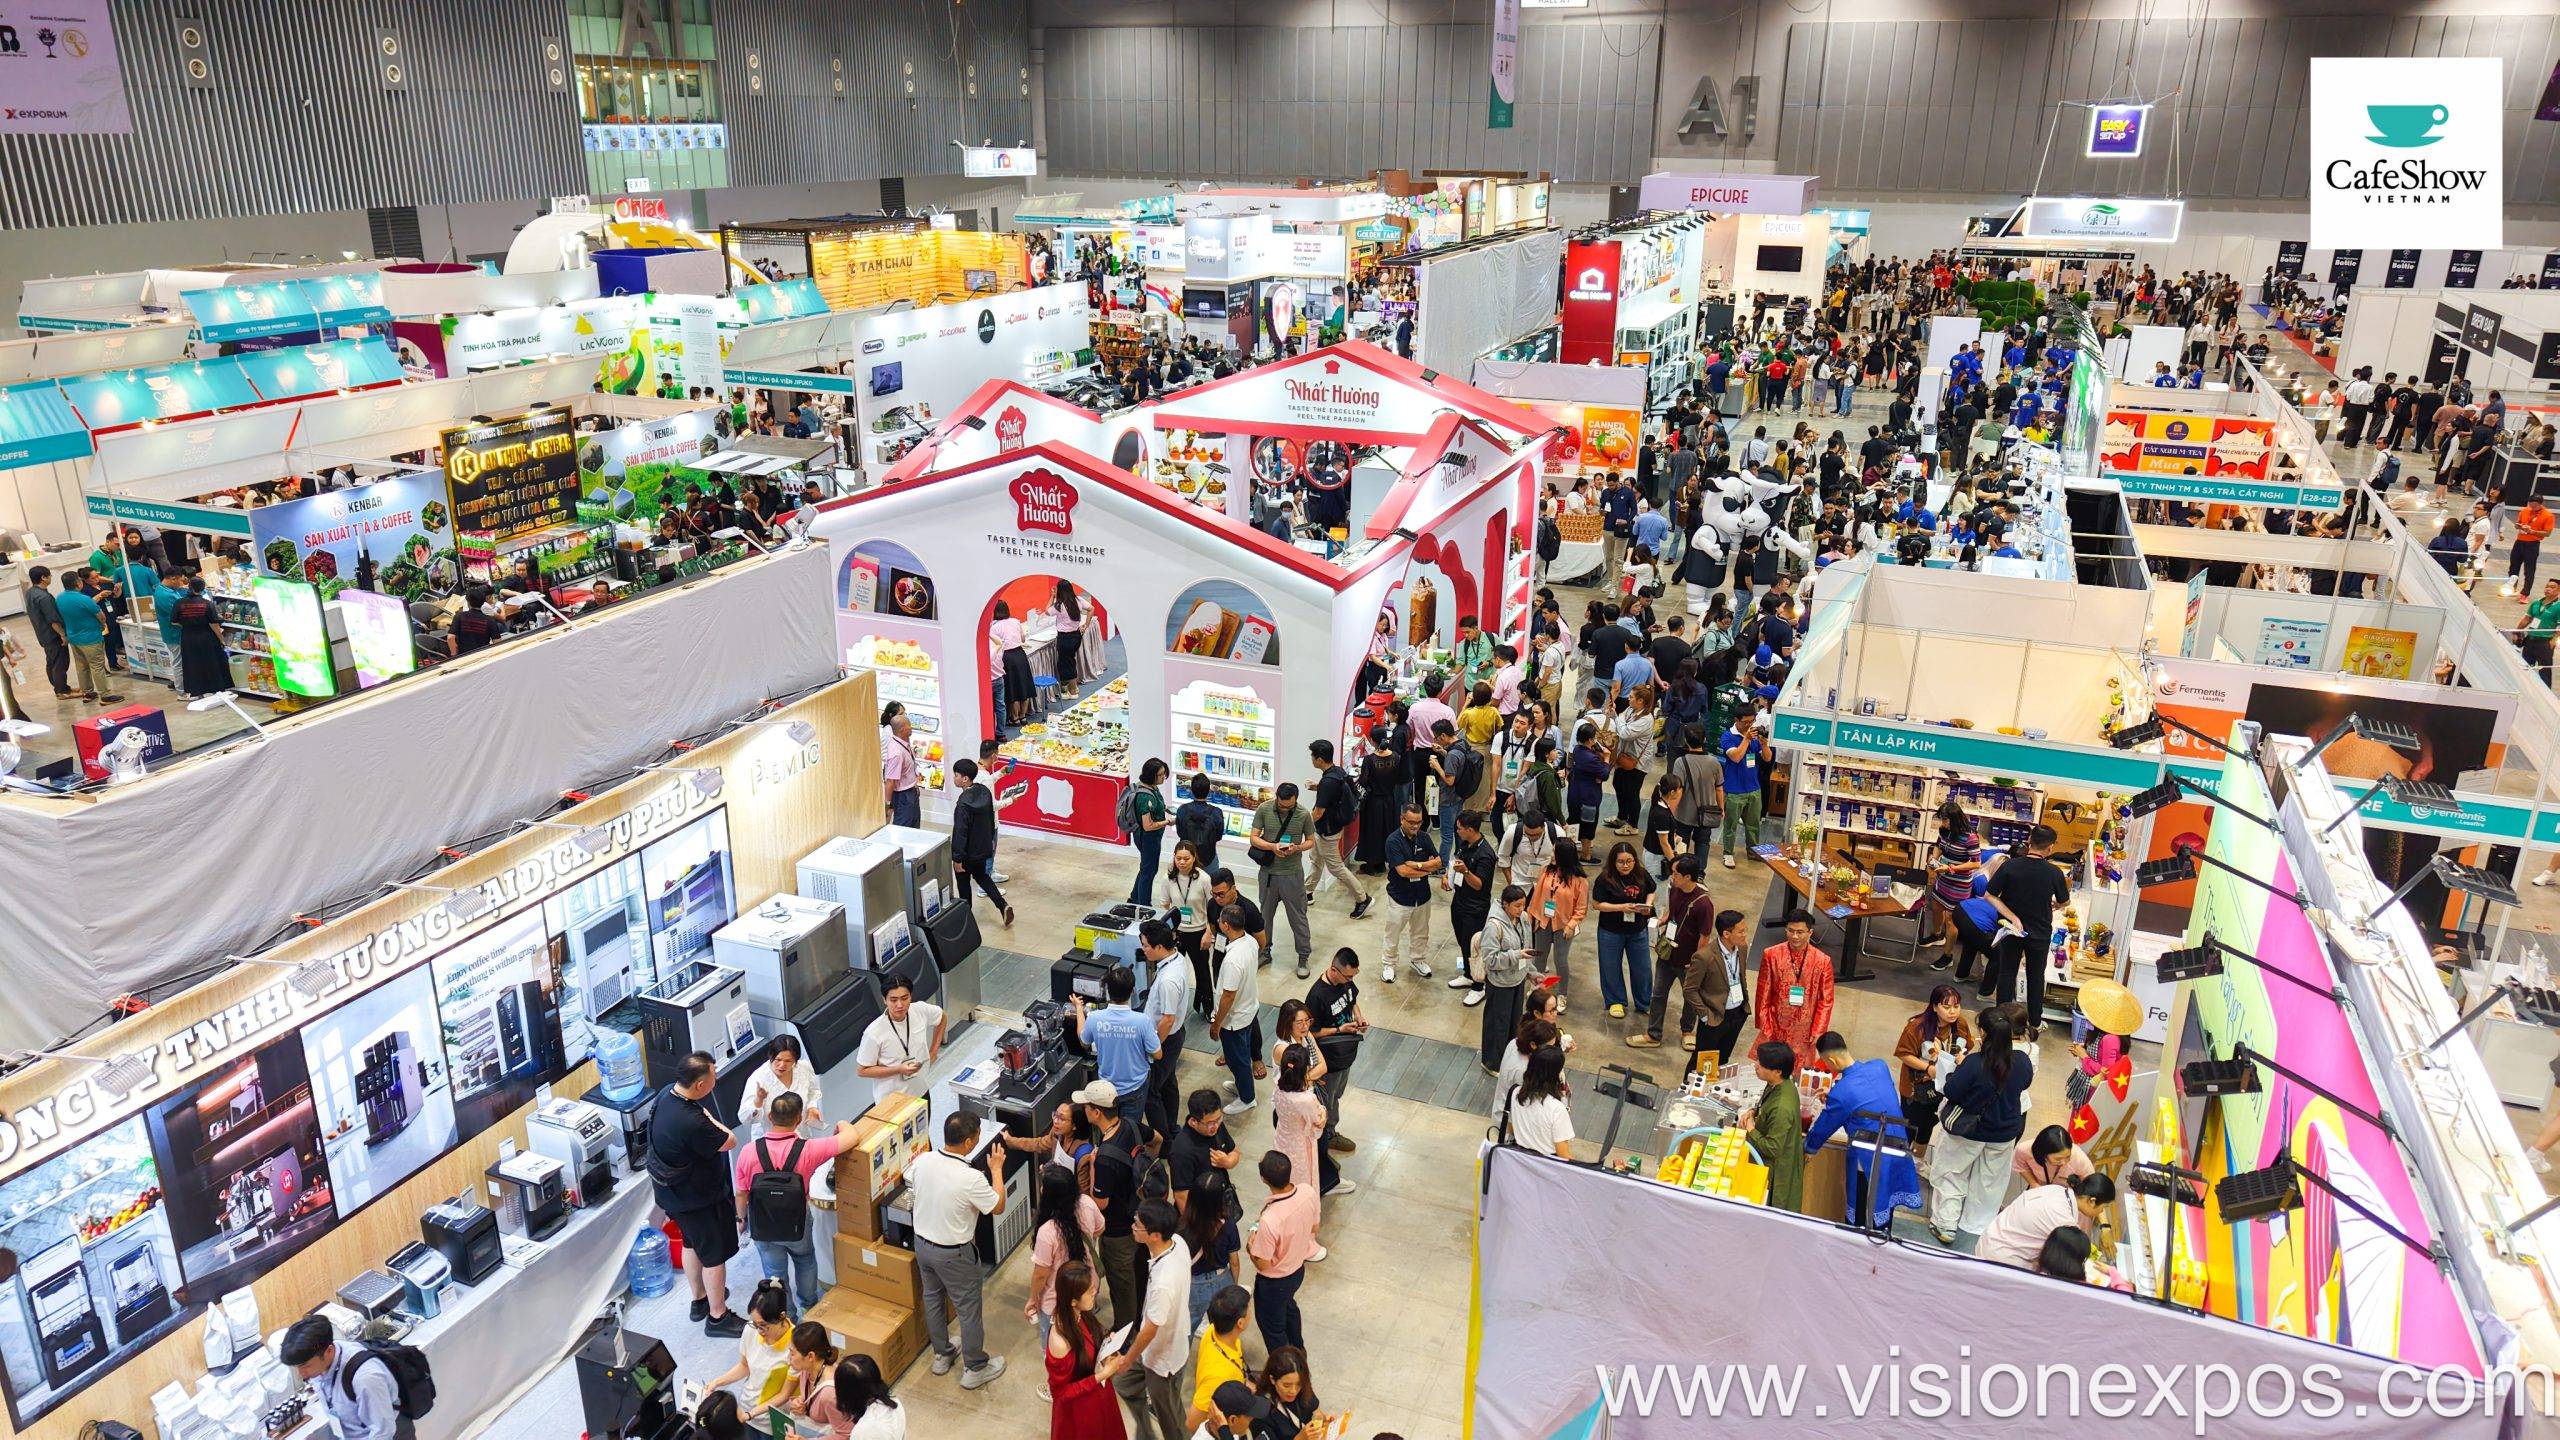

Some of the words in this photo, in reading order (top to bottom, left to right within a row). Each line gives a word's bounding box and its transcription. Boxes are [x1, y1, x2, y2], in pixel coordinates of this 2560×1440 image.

[1691, 188, 1749, 204] EPICURE
[481, 342, 497, 351] HOA
[512, 337, 527, 347] PHA
[528, 331, 542, 345] CHẾ
[1284, 378, 1330, 402] Nhất
[1332, 384, 1380, 409] Hương
[1287, 404, 1310, 412] TASTE
[1329, 407, 1376, 416] EXCELLENCE
[1333, 415, 1366, 423] PASSION
[1587, 420, 1626, 431] CANNED
[657, 444, 670, 458] TRÀ
[676, 438, 698, 454] COFFEE
[2149, 459, 2179, 471] Mua
[1020, 482, 1068, 509] Nhất
[2137, 481, 2148, 490] TY
[2150, 482, 2175, 492] TNHH
[2178, 484, 2192, 493] TM
[2194, 486, 2200, 494] &
[2202, 486, 2214, 495] SX
[2217, 485, 2236, 496] TRÀ
[2238, 487, 2257, 498] CÁT
[2260, 490, 2284, 500] NGHI
[2303, 494, 2338, 504] E28-E29
[116, 505, 135, 514] CASA
[136, 507, 149, 517] TEA
[155, 510, 176, 520] FOOD
[348, 496, 383, 514] KENBAR
[372, 519, 380, 531] &
[381, 510, 414, 530] COFFEE
[1023, 503, 1067, 528] Hương
[987, 534, 1017, 545] TASTE
[1020, 538, 1039, 548] THE
[1043, 541, 1106, 556] EXCELLENCE
[1000, 546, 1023, 556] FEEL
[1027, 549, 1046, 559] THE
[1049, 552, 1092, 565] PASSION
[2179, 684, 2226, 698] Fermentis
[1790, 722, 1816, 736] F27
[1842, 729, 1872, 744] TÂN
[1876, 733, 1906, 749] LẬP
[1909, 739, 1937, 753] KIM
[2433, 808, 2487, 822] Fermentis
[164, 981, 293, 1072] TNHH
[634, 778, 690, 837] PHÚ
[446, 962, 472, 984] Enjoy
[468, 954, 490, 973] coffee
[489, 944, 507, 961] time
[449, 970, 490, 998] Everything
[495, 955, 520, 972] within
[517, 943, 538, 960] grasp
